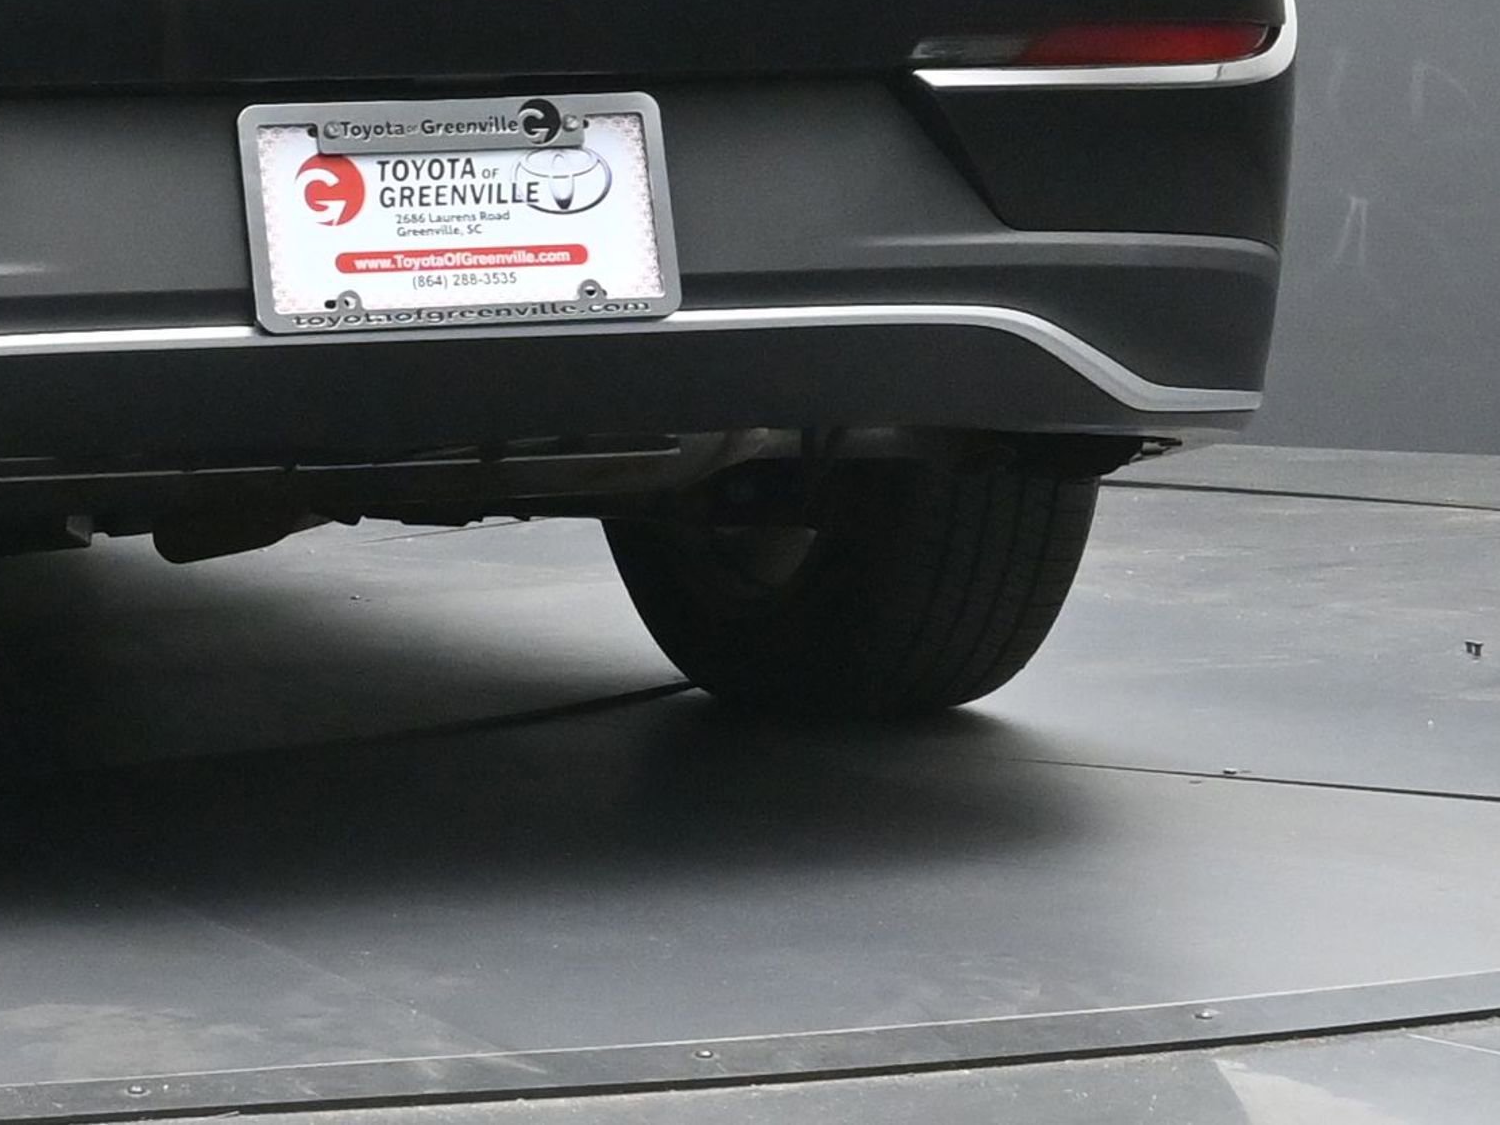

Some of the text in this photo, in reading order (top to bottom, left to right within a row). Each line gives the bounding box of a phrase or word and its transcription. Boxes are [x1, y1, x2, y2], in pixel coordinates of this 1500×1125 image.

[341, 120, 405, 142] Toyota
[421, 116, 520, 136] Greenville
[376, 157, 501, 182] TOYOTA OF
[379, 181, 541, 209] GREENVILLE
[428, 212, 477, 223] Laurens
[479, 210, 511, 221] Road
[396, 223, 483, 237] Greenville, SC
[353, 249, 572, 271] www.ToyotaOfGreenville.com
[412, 271, 518, 290] (864) 288-3535
[293, 300, 651, 328] toyotaofgreenville.com
